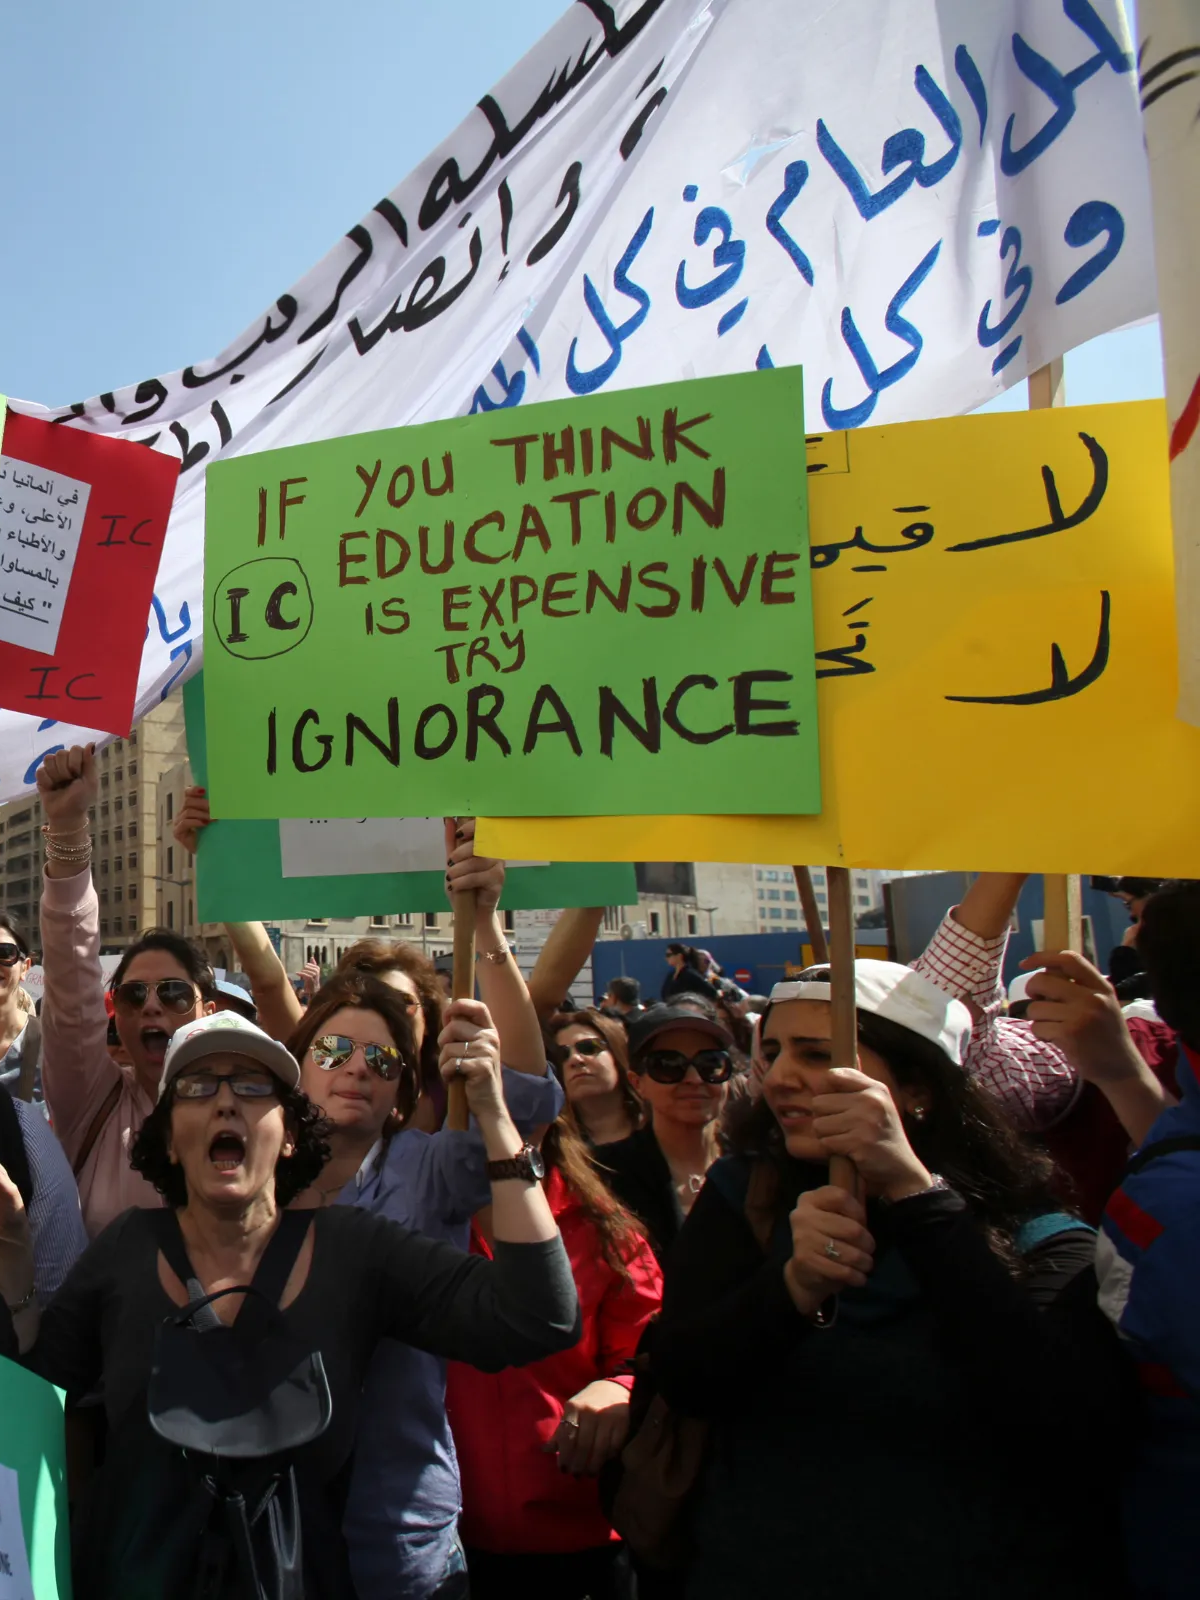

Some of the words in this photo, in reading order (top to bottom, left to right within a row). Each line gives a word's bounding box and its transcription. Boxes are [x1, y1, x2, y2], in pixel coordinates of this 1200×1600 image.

[766, 44, 988, 287] العام
[565, 206, 654, 395] كل
[675, 184, 749, 336] في
[57, 489, 79, 507] في
[257, 476, 308, 547] IF
[355, 451, 454, 517] YOU
[490, 407, 712, 485] THINK
[96, 515, 153, 547] IC
[337, 467, 726, 588] EDUCATION
[226, 580, 300, 643] IC
[365, 597, 410, 636] IS
[442, 552, 800, 633] EXPENSIVE
[25, 667, 103, 701] IC
[434, 630, 526, 684] TRY
[266, 669, 800, 775] IGNORANCE
